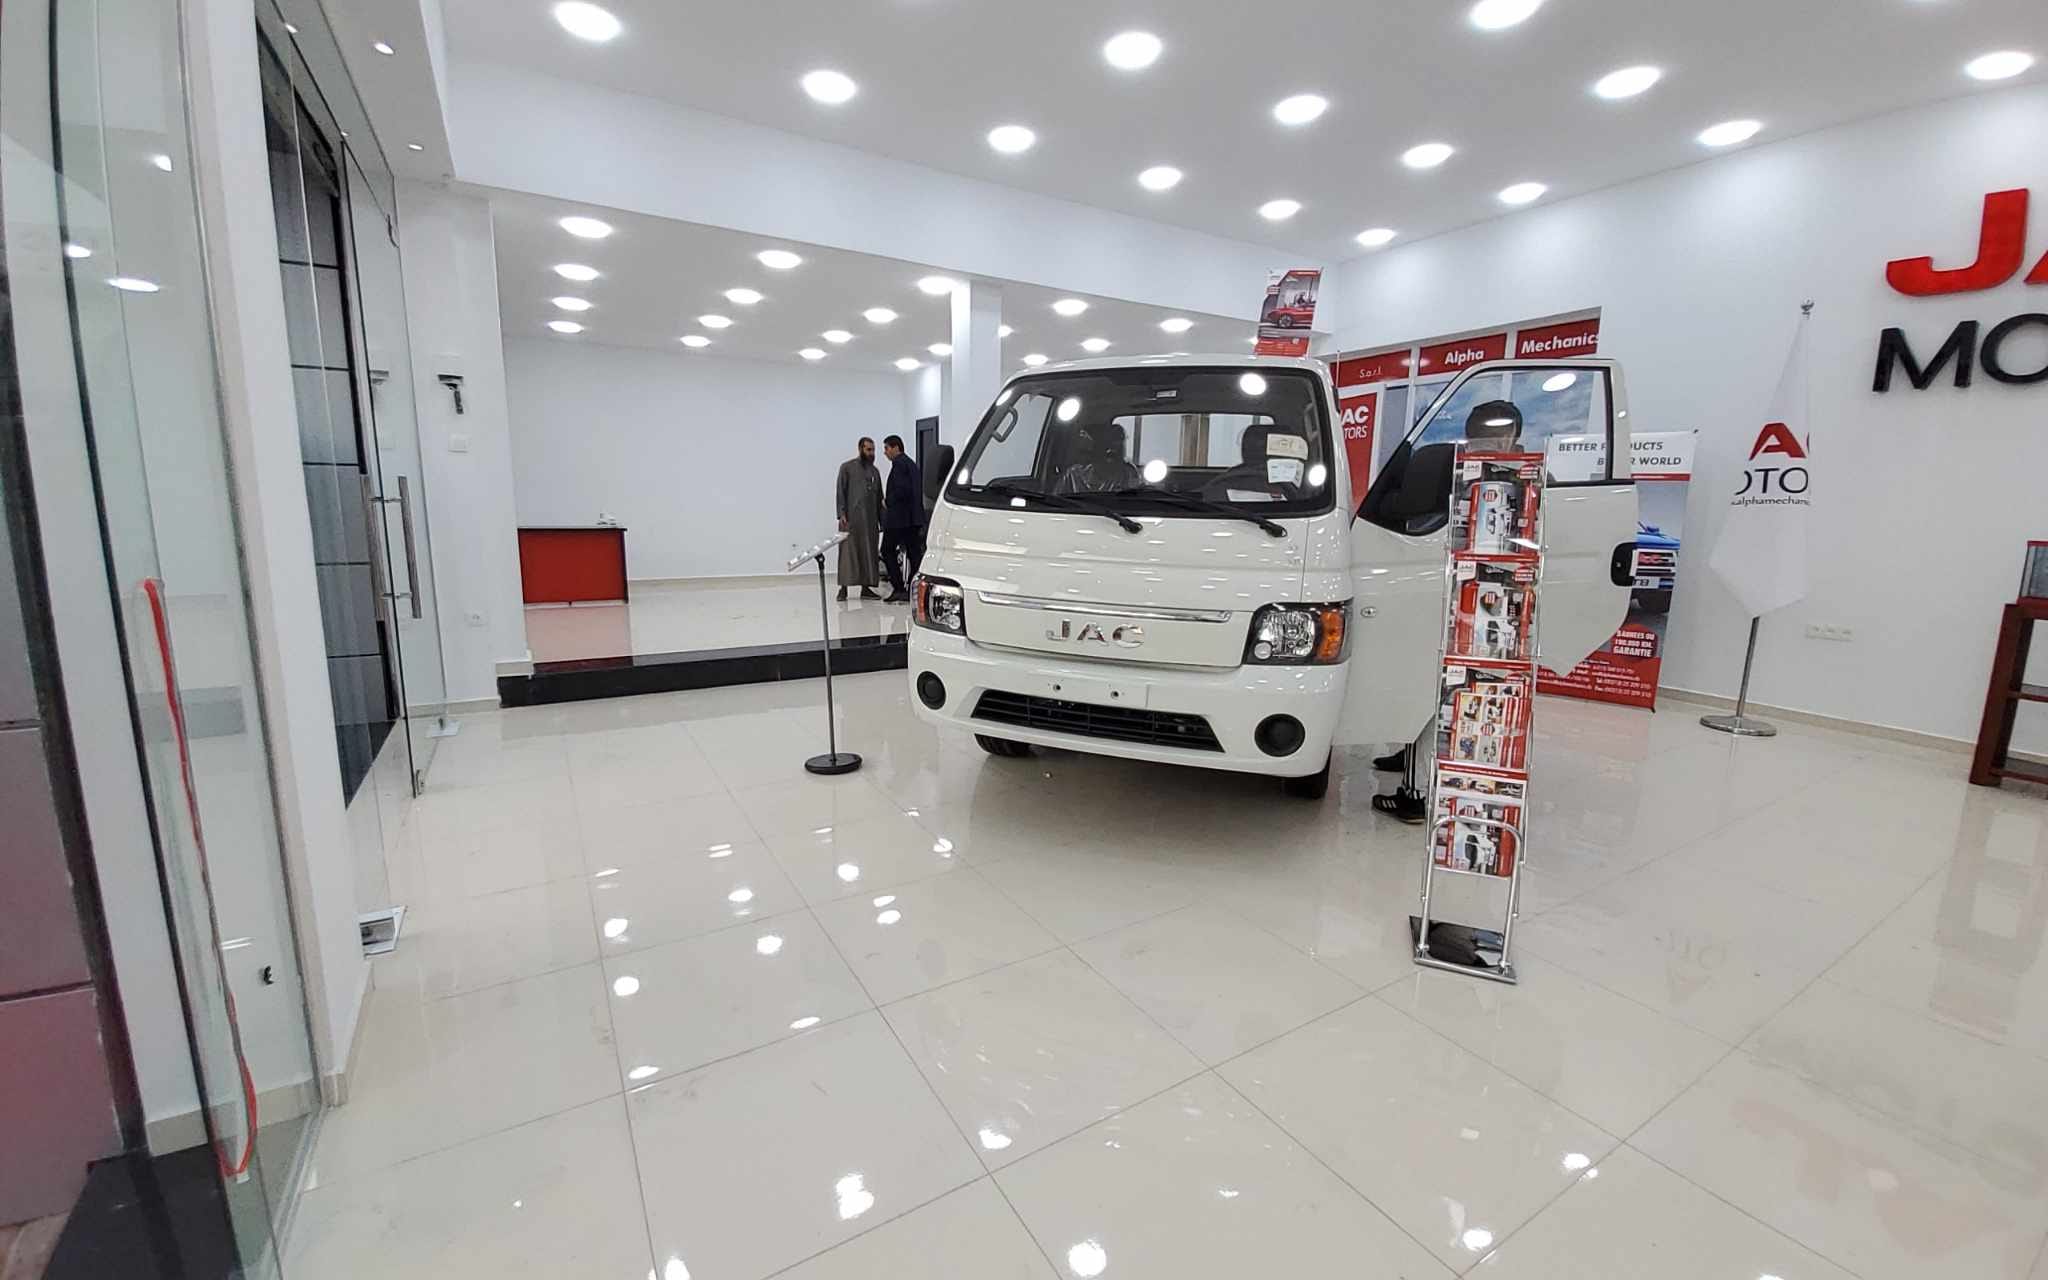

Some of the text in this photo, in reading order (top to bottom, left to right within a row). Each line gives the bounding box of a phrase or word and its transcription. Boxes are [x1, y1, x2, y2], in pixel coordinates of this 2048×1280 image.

[1886, 187, 2048, 297] J
[1444, 348, 1485, 366] Alpha
[1340, 405, 1369, 426] AC
[1343, 425, 1369, 440] TORS
[1748, 422, 1809, 461] A
[1558, 442, 1597, 452] BETTER
[1639, 456, 1682, 466] WORLD
[1046, 618, 1145, 648] JAC
[1613, 646, 1653, 657] GARANTIE
